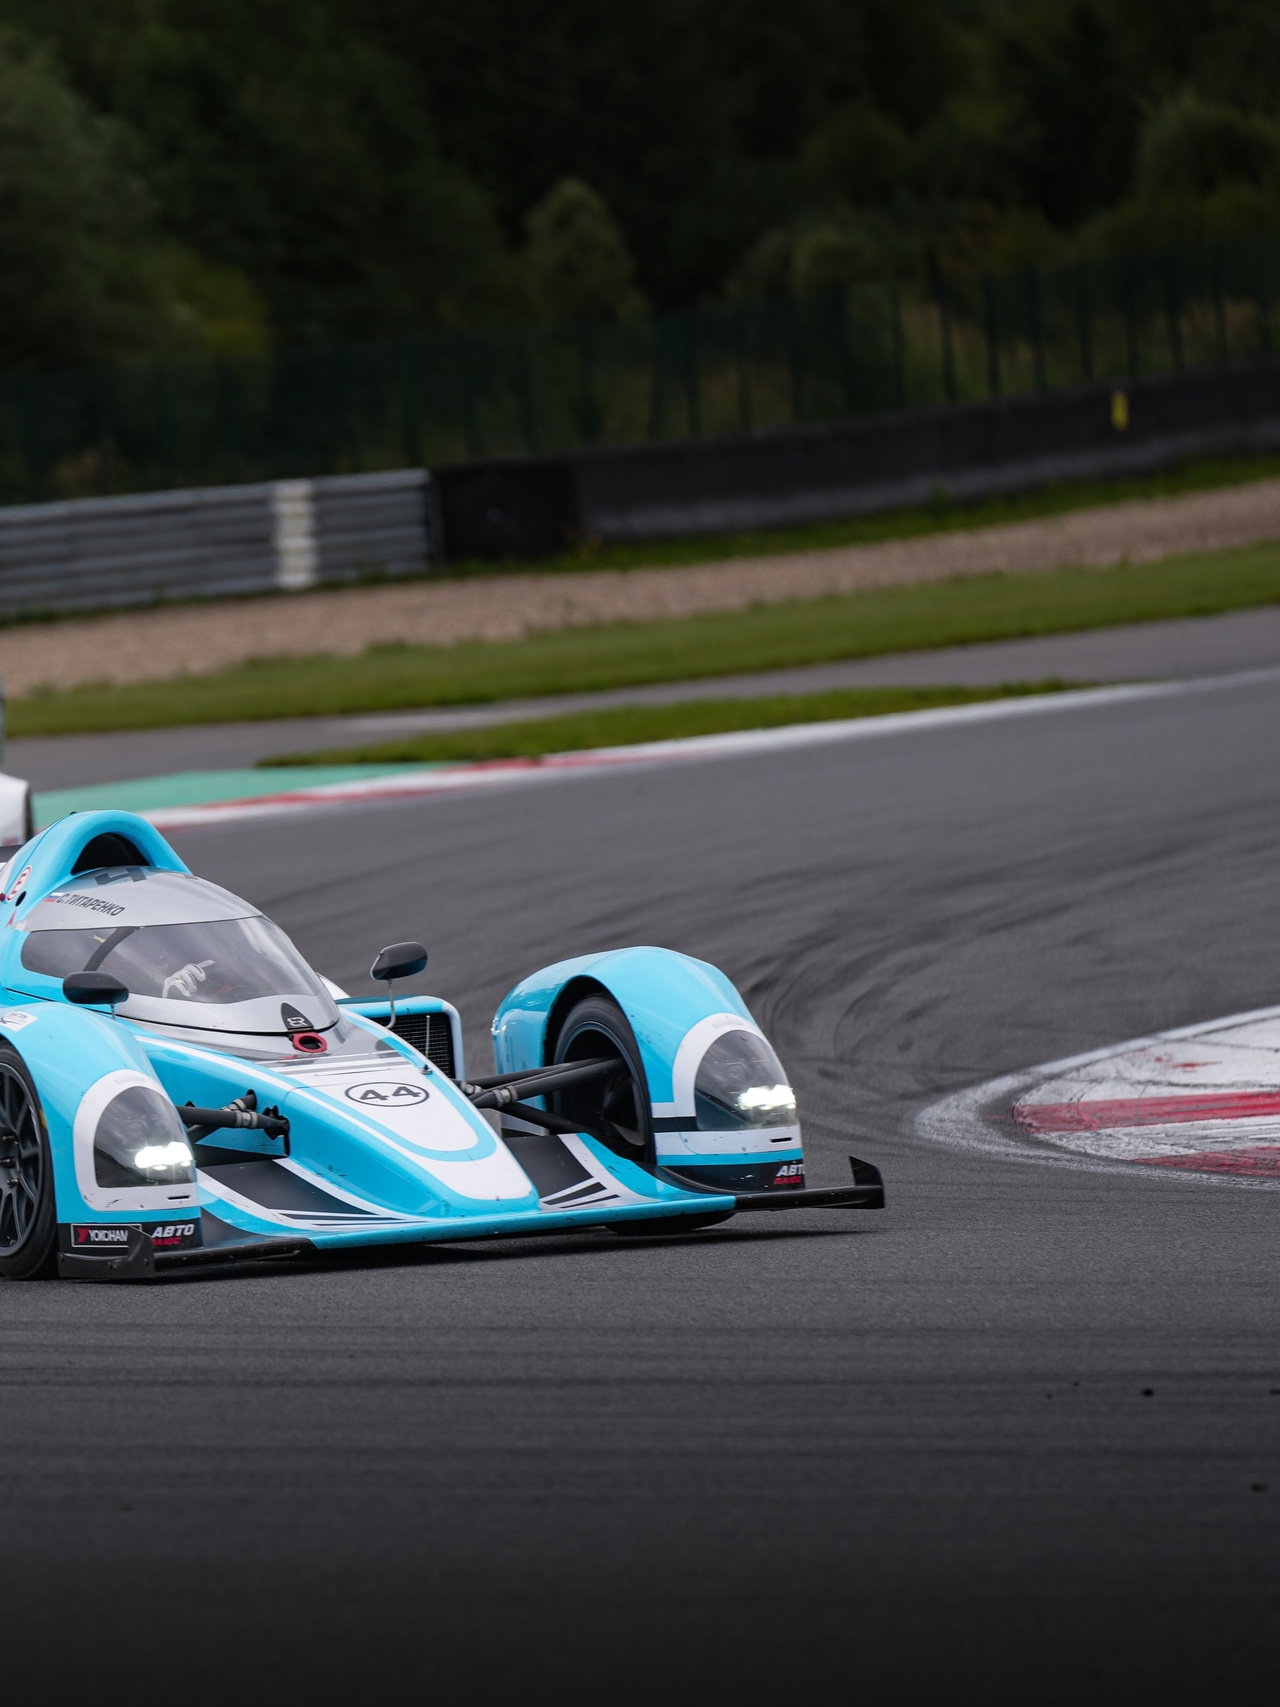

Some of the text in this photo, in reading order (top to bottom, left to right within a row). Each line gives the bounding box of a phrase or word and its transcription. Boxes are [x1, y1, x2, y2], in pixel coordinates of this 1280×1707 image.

[56, 893, 126, 917] С.ТИТАРЕНКО
[359, 1085, 422, 1101] 44
[88, 1229, 129, 1242] YOKOHAM
[151, 1223, 195, 1238] АВТО
